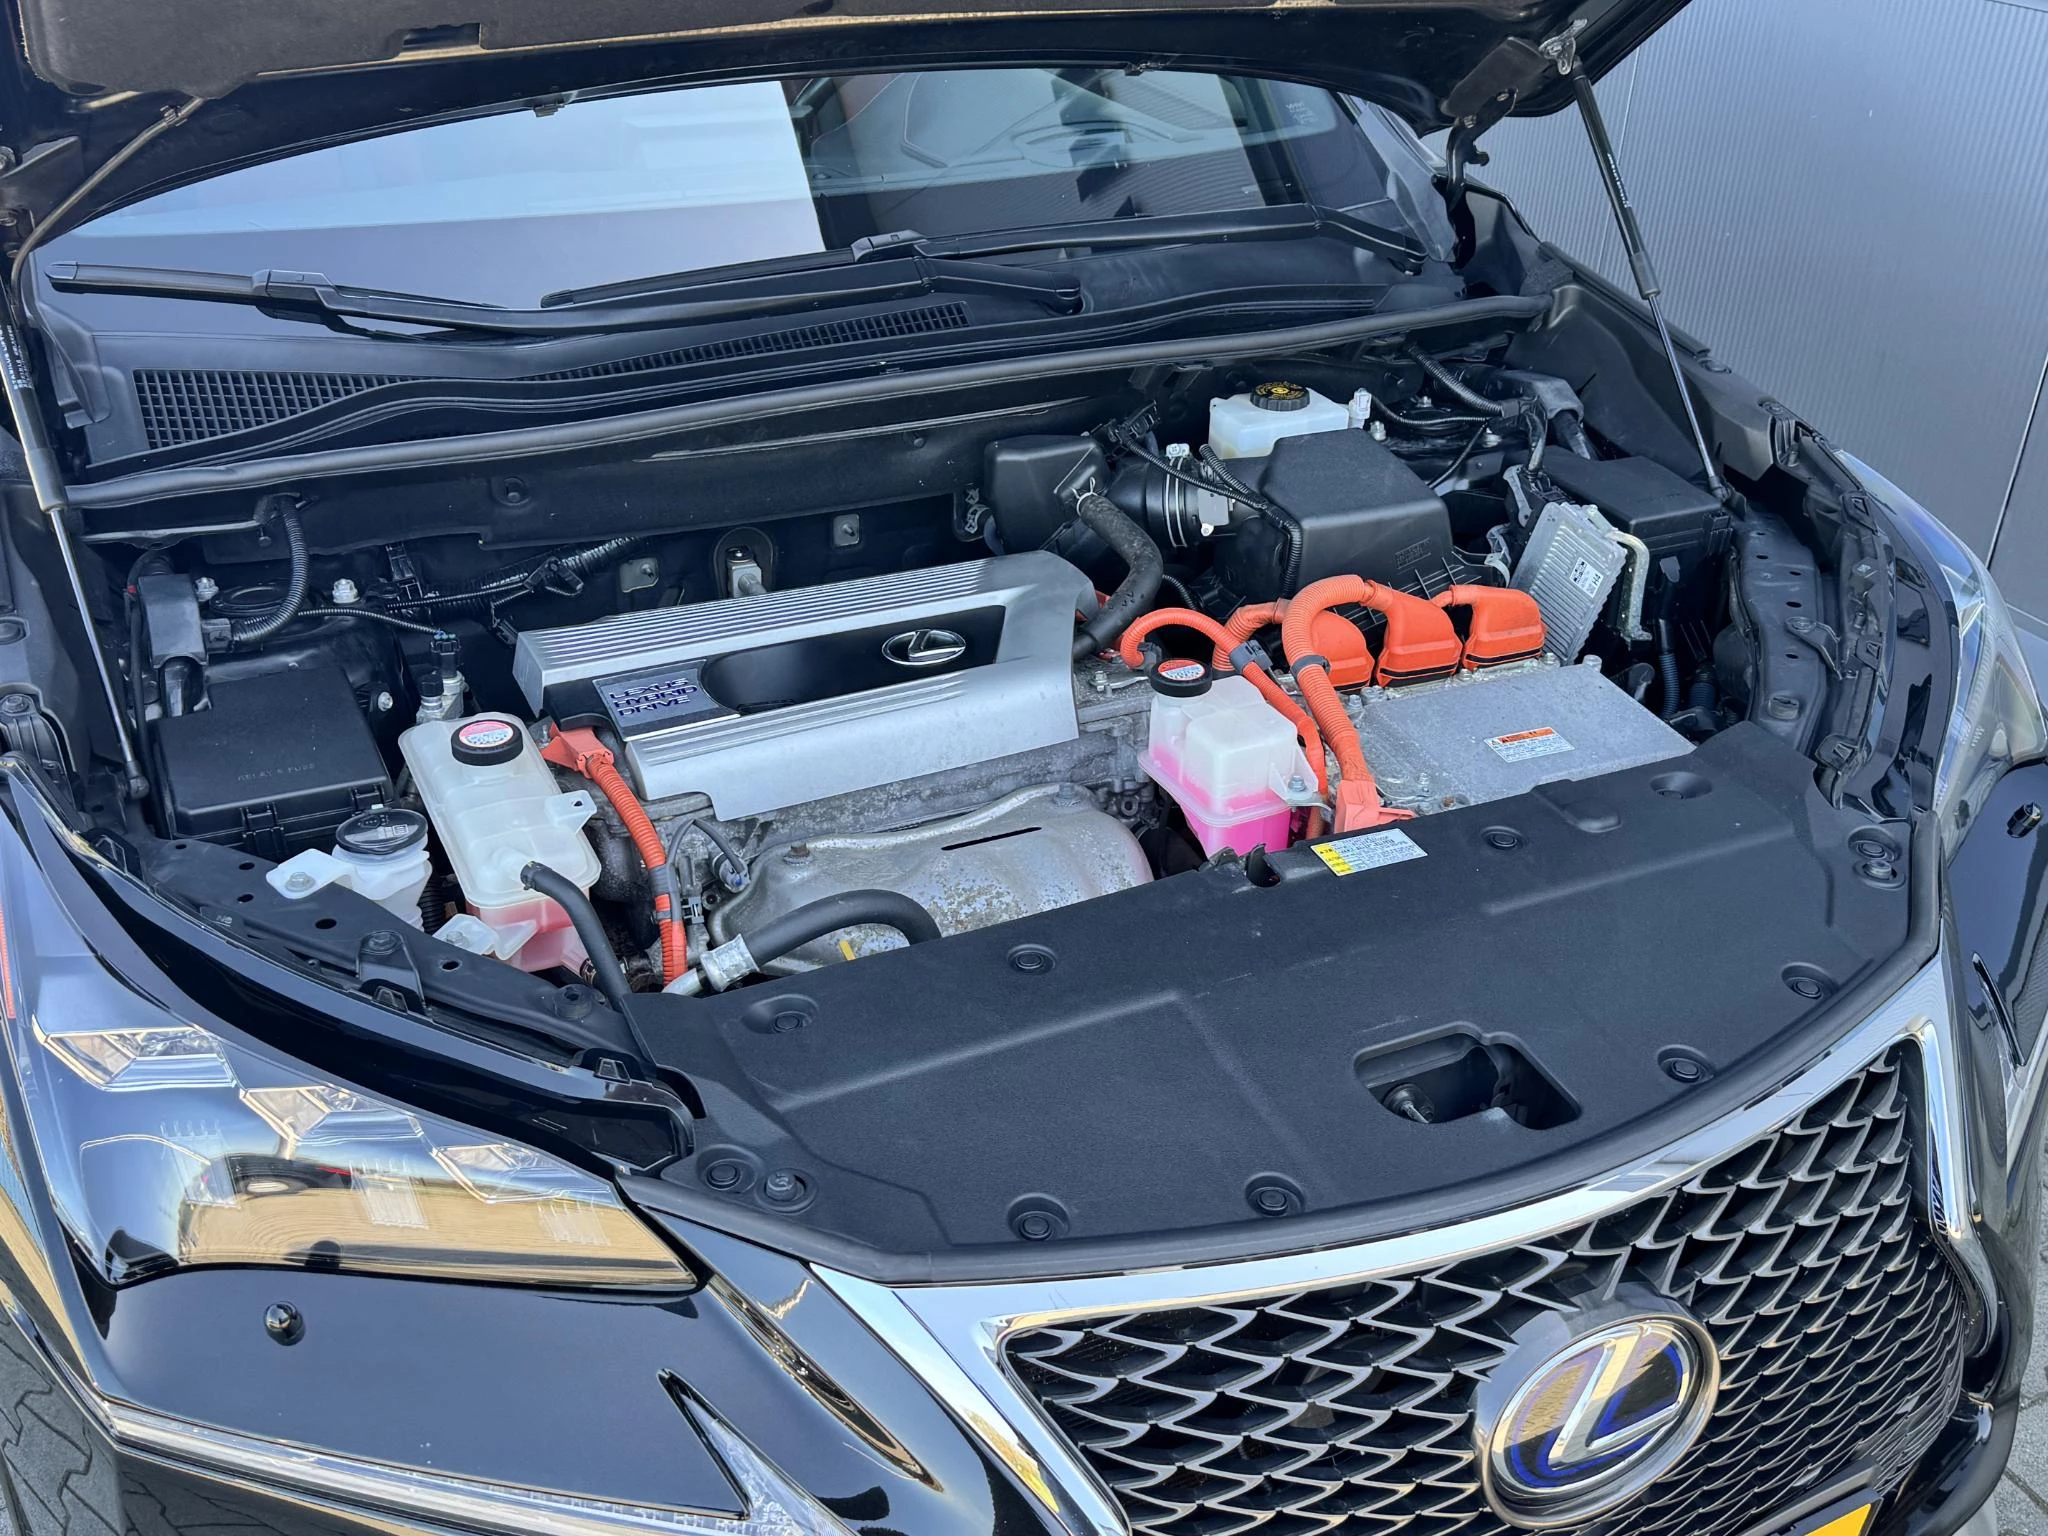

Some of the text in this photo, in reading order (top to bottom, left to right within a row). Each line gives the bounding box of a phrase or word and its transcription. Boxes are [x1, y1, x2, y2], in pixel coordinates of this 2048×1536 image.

[609, 677, 689, 699] LEXUS
[612, 685, 698, 708] HYBRID
[617, 695, 691, 717] DRIVE
